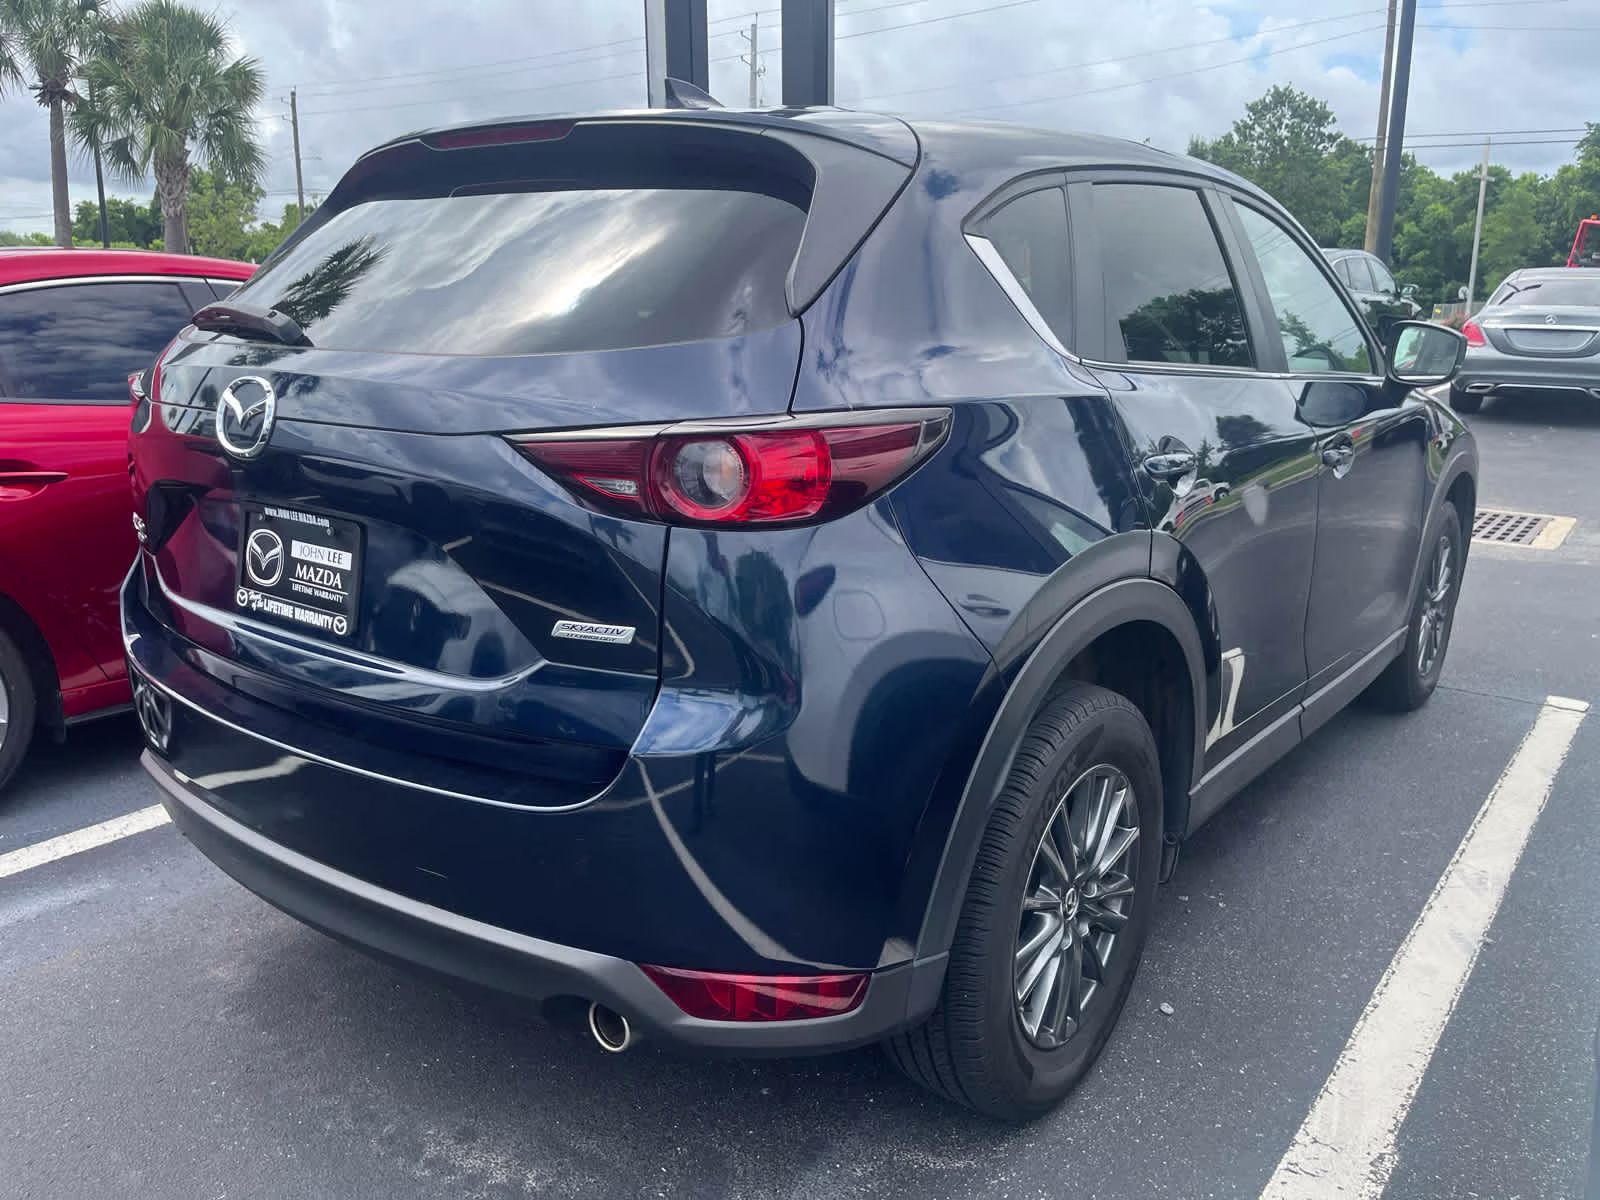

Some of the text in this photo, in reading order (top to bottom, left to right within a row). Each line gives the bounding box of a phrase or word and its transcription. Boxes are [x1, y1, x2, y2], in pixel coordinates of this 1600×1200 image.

[299, 544, 343, 564] JOHN LEE
[295, 563, 342, 589] MAZDA
[292, 583, 343, 603] LIFETIME WARRANTY
[264, 599, 294, 618] LIFETIME
[294, 608, 334, 629] WARRANTY
[561, 623, 626, 635] SKYACTIV
[566, 633, 617, 642] TECHNOLOGY
